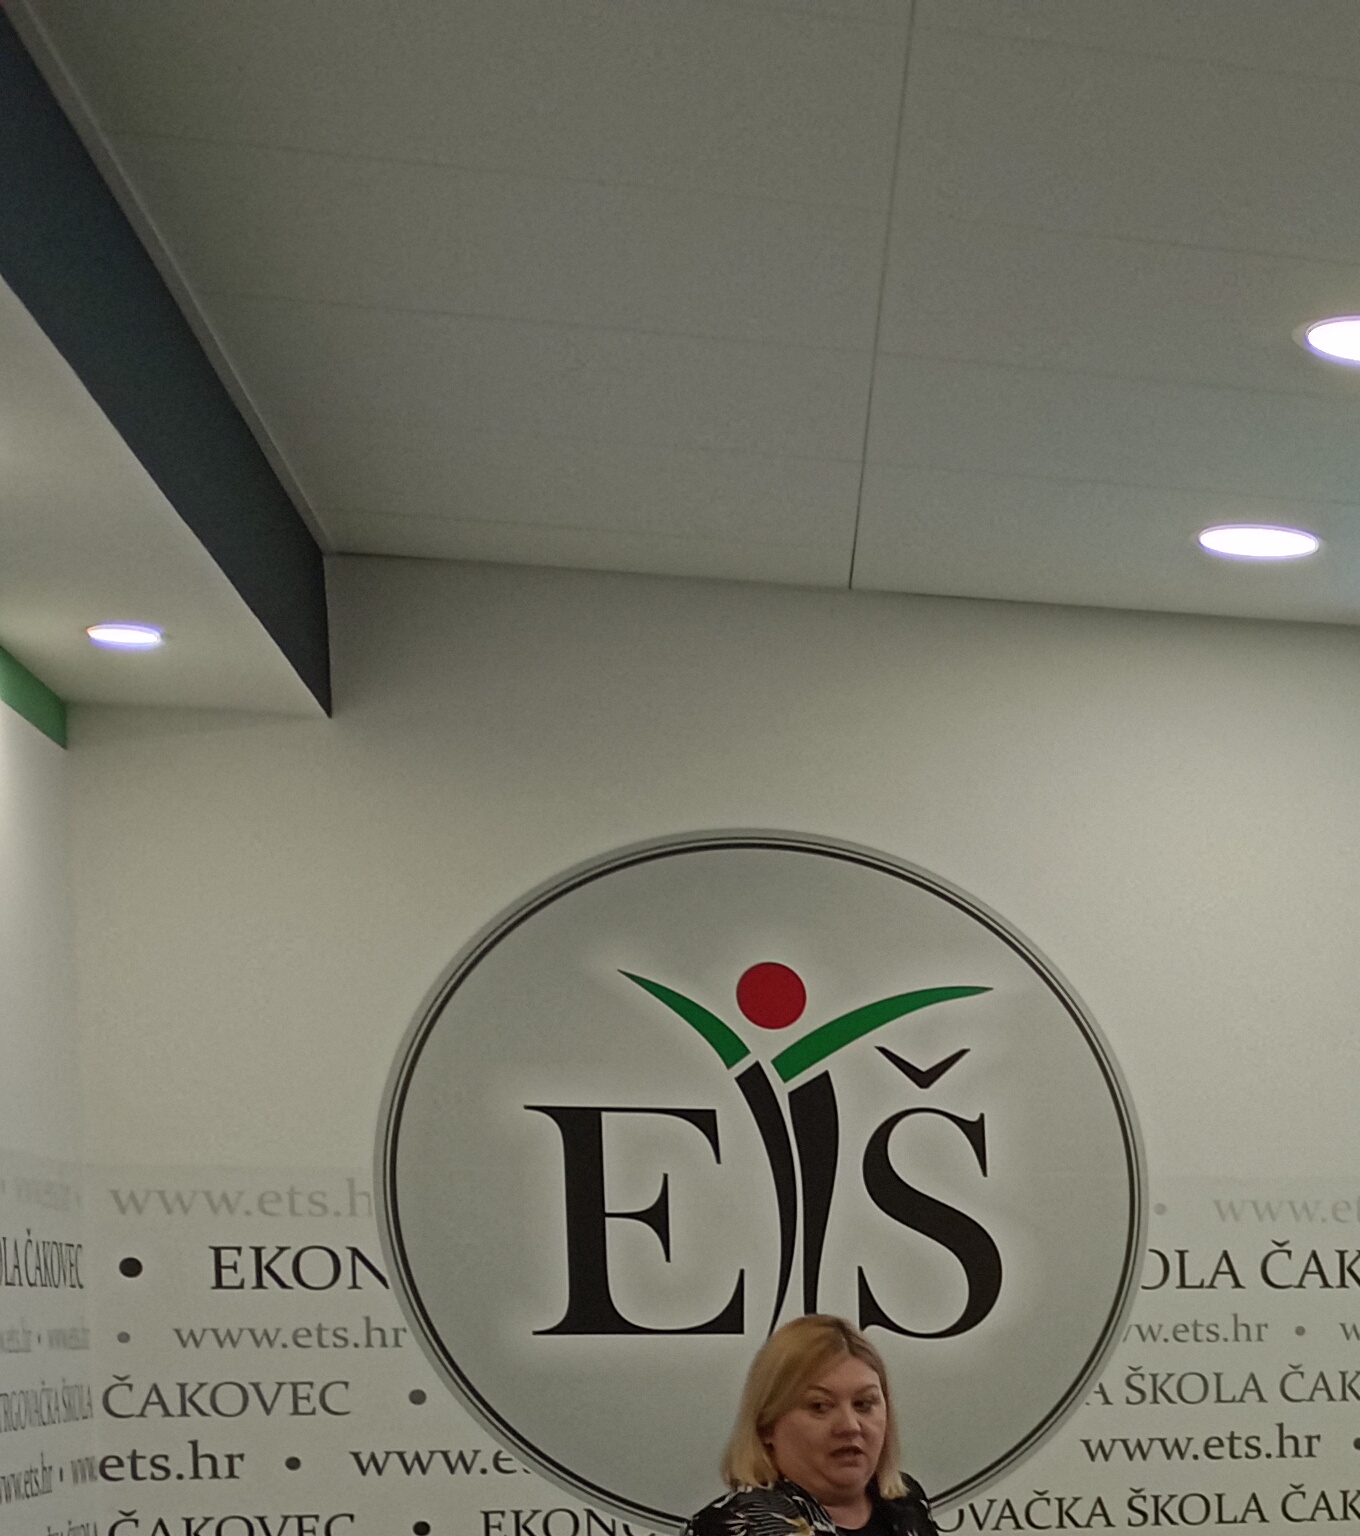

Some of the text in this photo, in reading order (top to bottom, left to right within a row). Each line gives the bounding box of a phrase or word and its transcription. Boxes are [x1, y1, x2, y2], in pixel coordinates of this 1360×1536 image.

[25, 1228, 84, 1290] ČAKOVEC
[172, 1316, 409, 1350] www.ets.hr
[102, 1374, 353, 1419] ČAKOVEC
[1124, 1365, 1267, 1406] ŠKOLA
[1080, 1422, 1322, 1463] www.ets.hr
[1127, 1487, 1271, 1528] ŠKOLA
